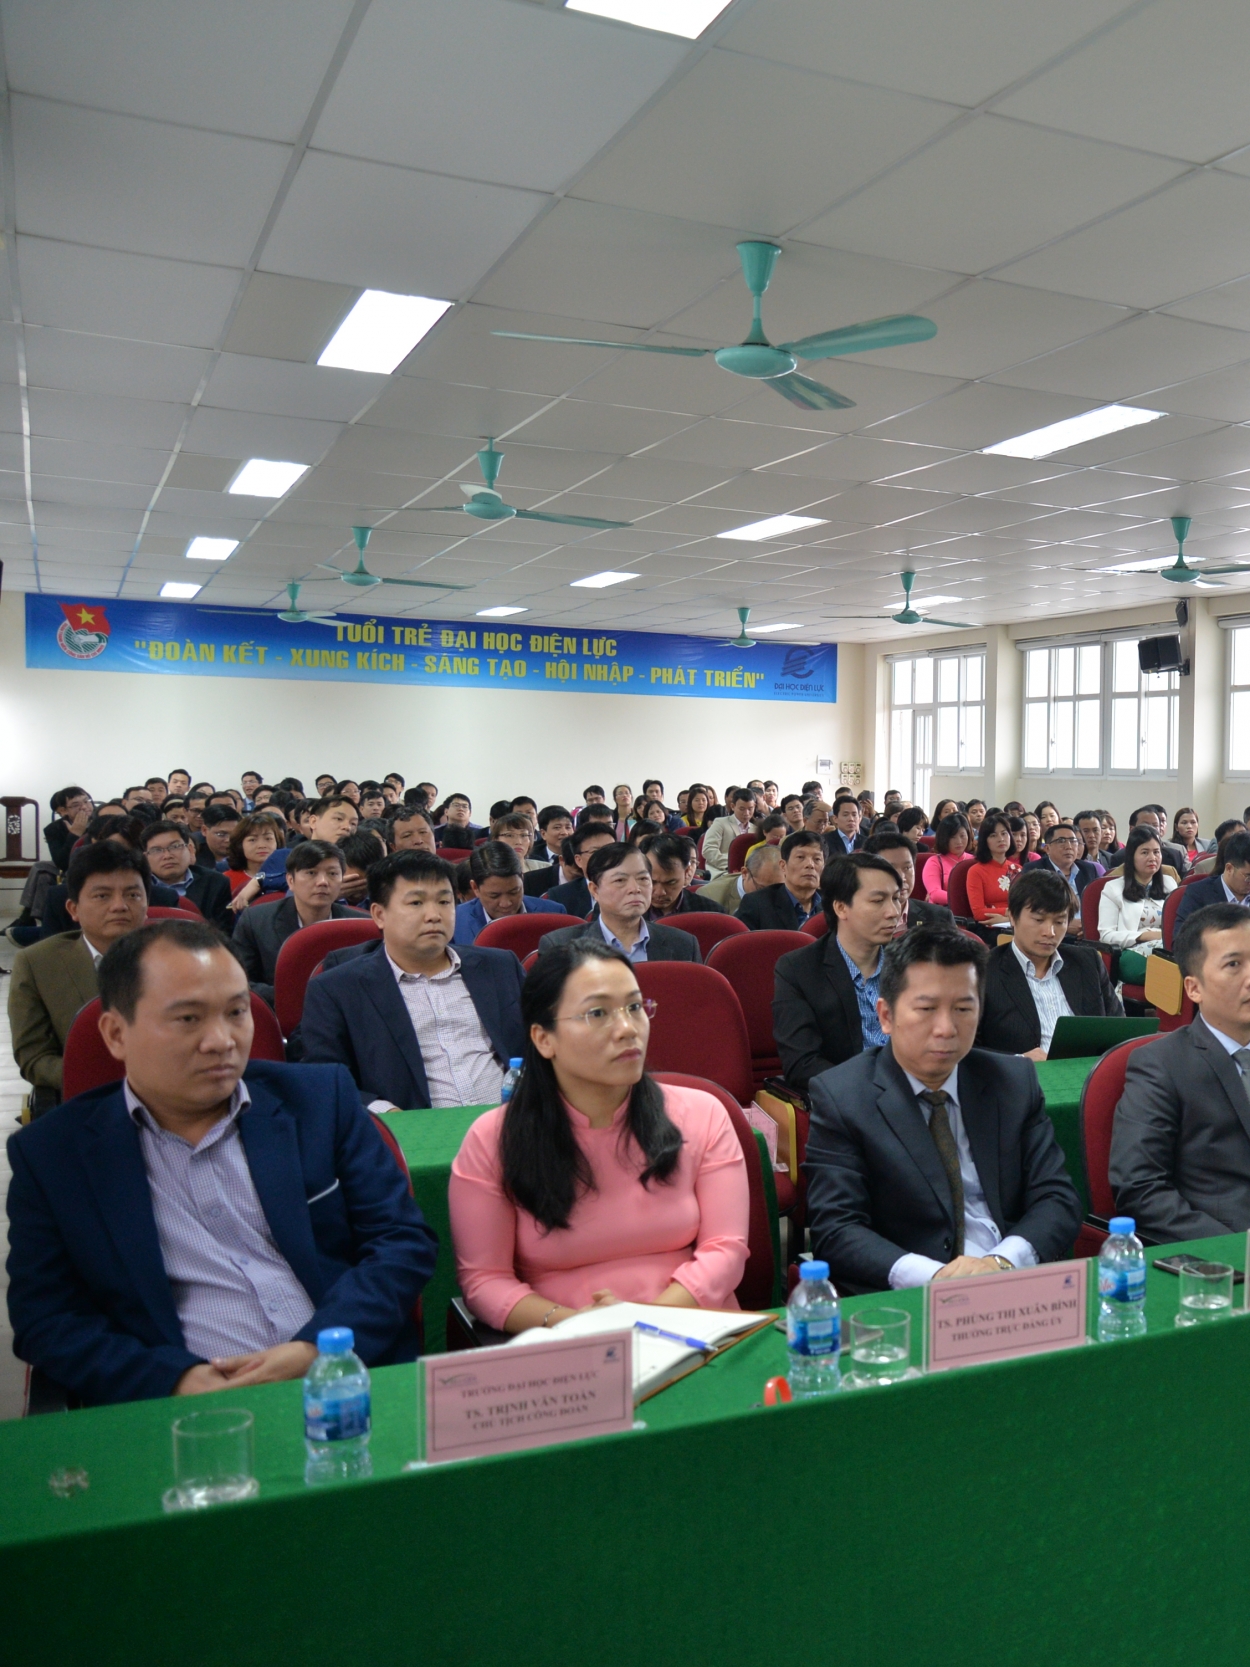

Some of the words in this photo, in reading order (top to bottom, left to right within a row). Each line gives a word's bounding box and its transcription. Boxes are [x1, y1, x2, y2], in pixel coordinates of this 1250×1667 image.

[337, 619, 384, 644] TUỔI
[391, 623, 432, 646] TRẺ
[440, 629, 477, 652] ĐẠI
[482, 632, 523, 654] HỌC
[529, 633, 577, 657] ĐIỆN
[582, 637, 617, 659] LỰC
[134, 639, 215, 663] "ĐOÀN
[223, 641, 268, 665] KẾT
[290, 648, 349, 669] XUNG
[356, 649, 405, 671] KÍCH
[424, 653, 480, 675] SÁNG
[487, 659, 527, 680] TẠO
[545, 659, 578, 683] HỘI
[583, 662, 634, 686] NHẬP
[651, 665, 697, 686] PHÁT
[704, 666, 765, 689] TRIỂN"
